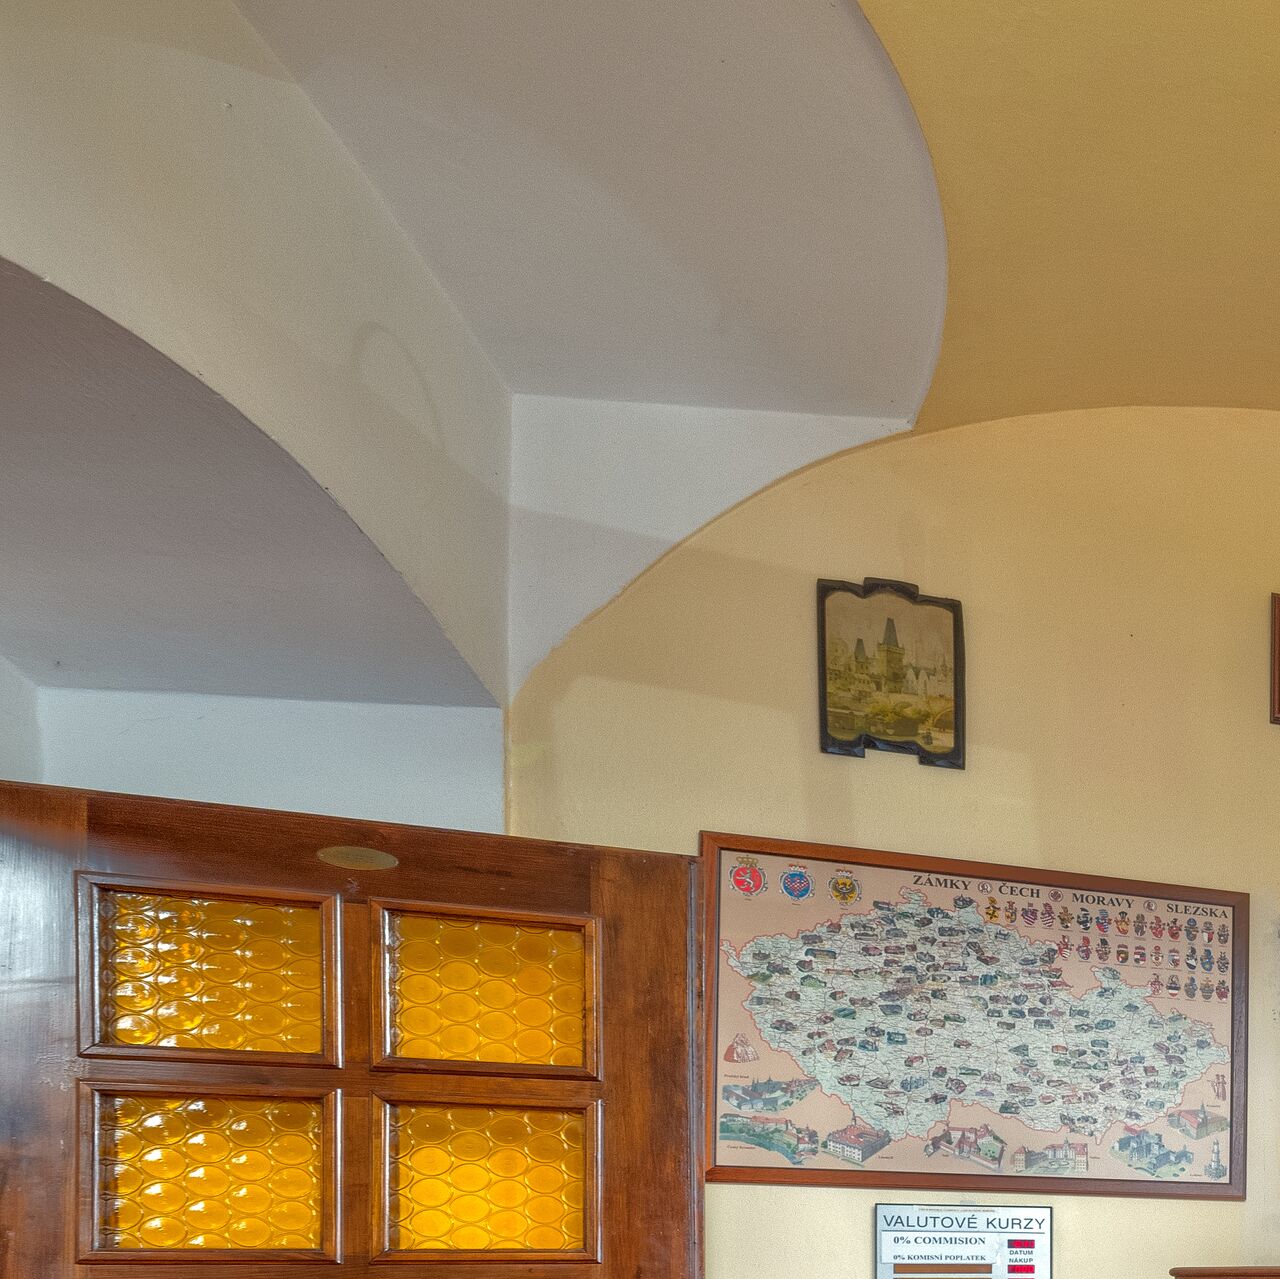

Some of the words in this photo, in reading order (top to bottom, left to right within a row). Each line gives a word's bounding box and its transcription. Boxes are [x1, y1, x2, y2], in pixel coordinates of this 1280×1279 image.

[913, 874, 972, 891] ZÁMKY
[999, 882, 1040, 899] ČECH
[1071, 892, 1136, 909] MORAVY
[1166, 903, 1229, 919] SLEZSKA
[883, 1215, 978, 1229] VALUTOVÉ
[986, 1218, 1046, 1230] KURZY
[893, 1236, 911, 1244] 0%
[914, 1236, 986, 1245] COMMISION
